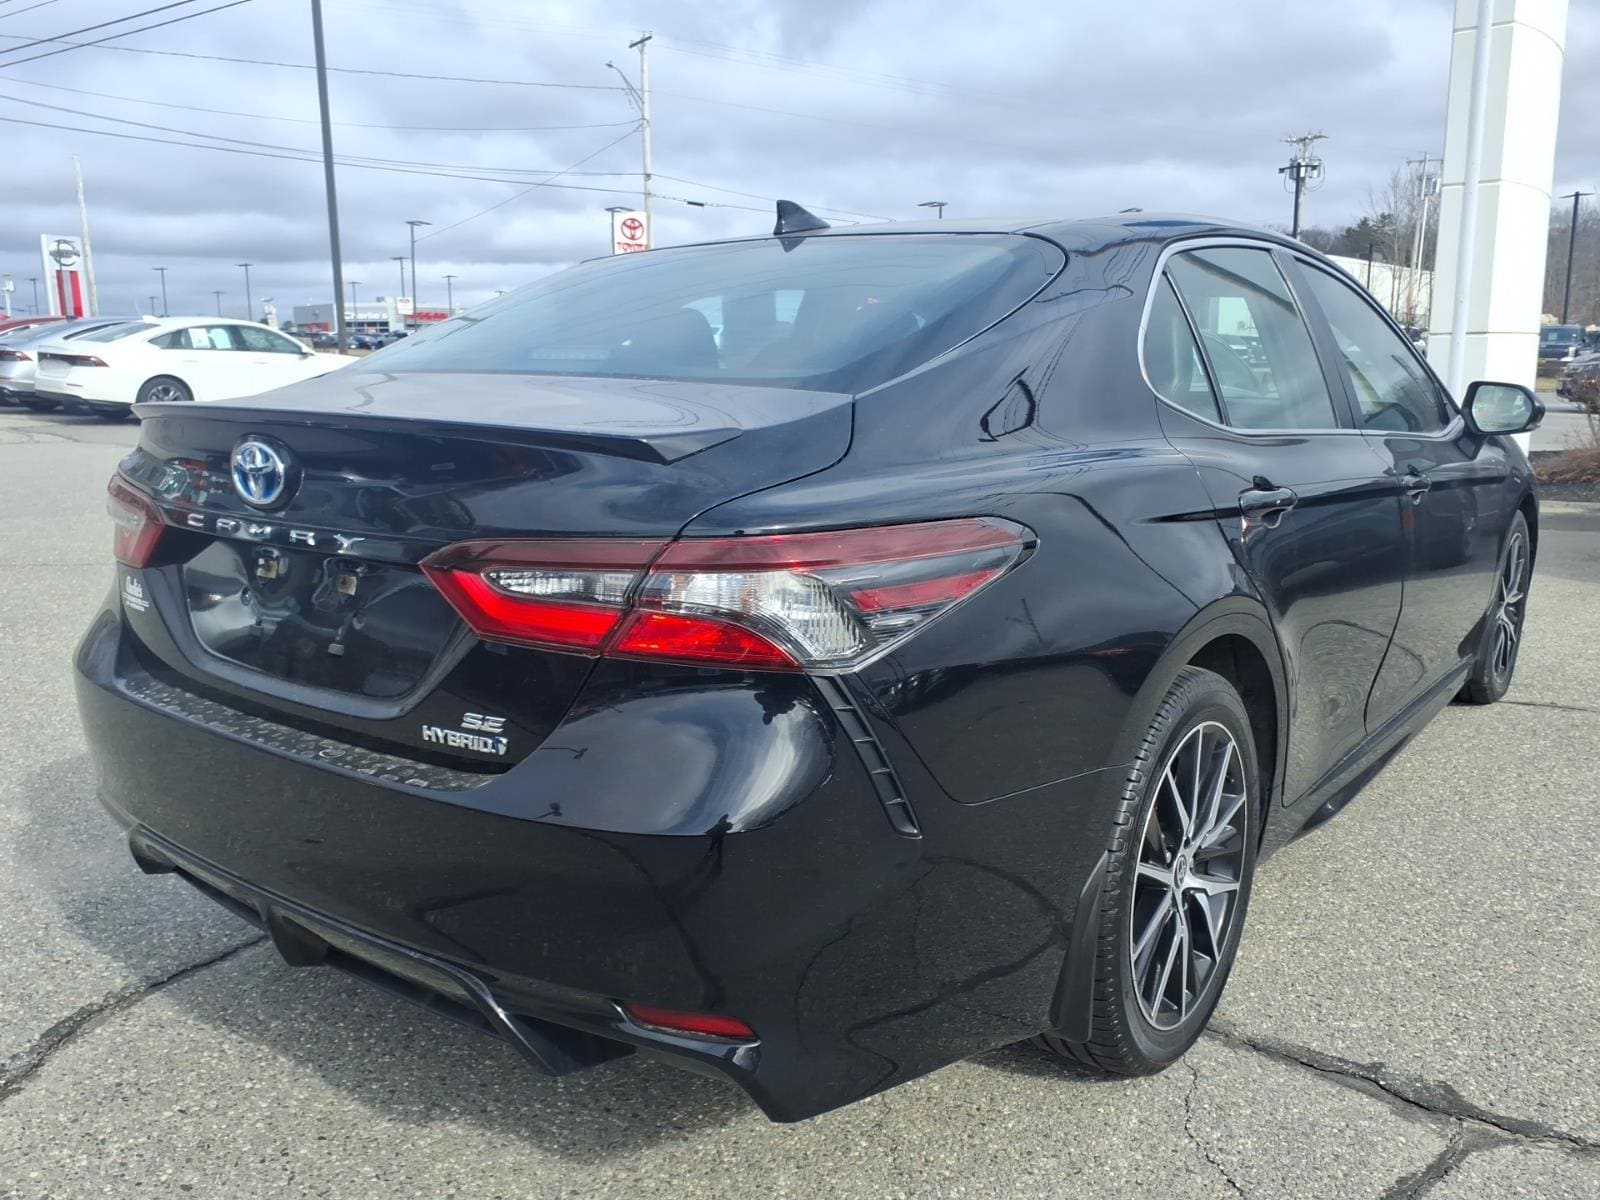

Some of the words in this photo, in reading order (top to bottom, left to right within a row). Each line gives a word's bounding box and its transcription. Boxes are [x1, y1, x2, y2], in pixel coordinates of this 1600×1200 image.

[187, 513, 365, 553] CAMRY
[460, 712, 506, 733] SE
[422, 725, 492, 753] HYBRID
